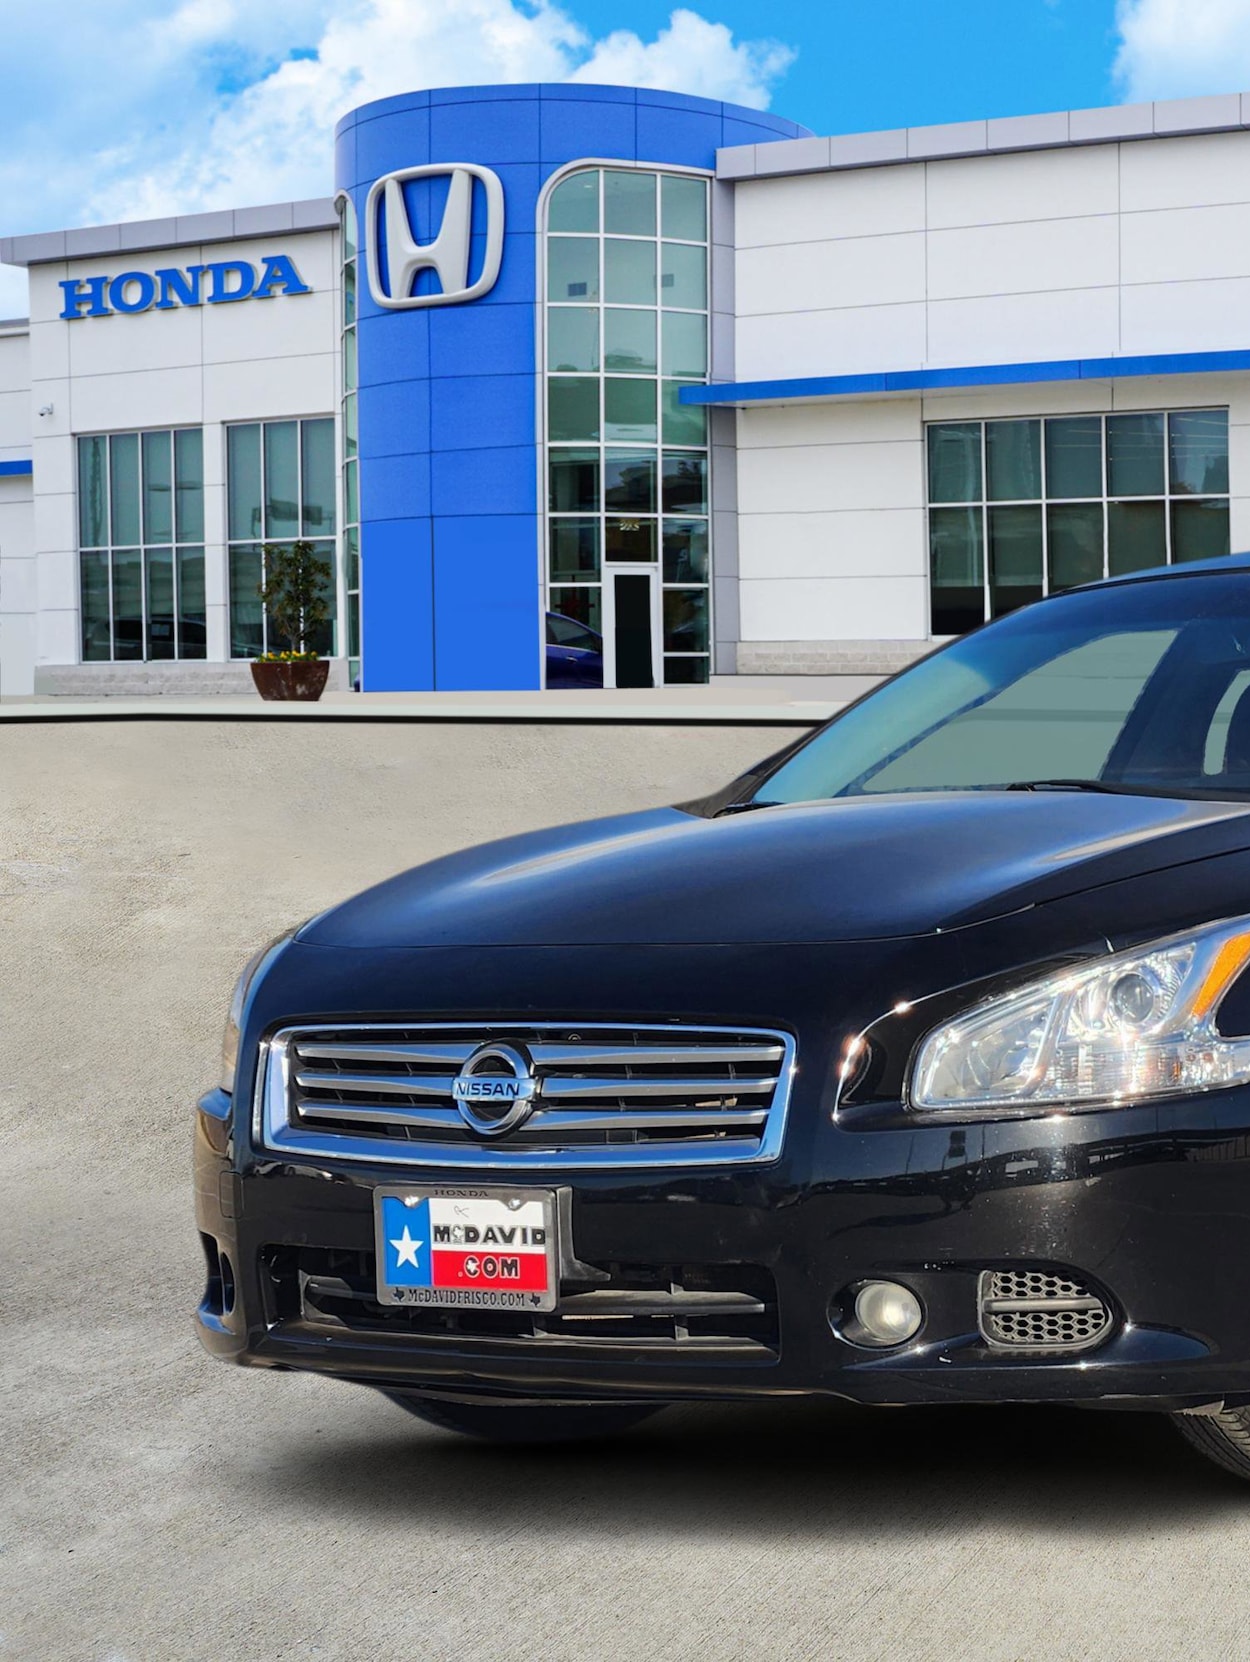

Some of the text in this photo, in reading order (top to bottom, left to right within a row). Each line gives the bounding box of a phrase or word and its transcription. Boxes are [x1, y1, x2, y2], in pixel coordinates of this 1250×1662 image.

[59, 255, 310, 319] HONDA
[456, 1083, 520, 1096] NISSAN
[434, 1189, 489, 1197] HONDA
[408, 1289, 525, 1306] McDAVIDFRISCO.COM
